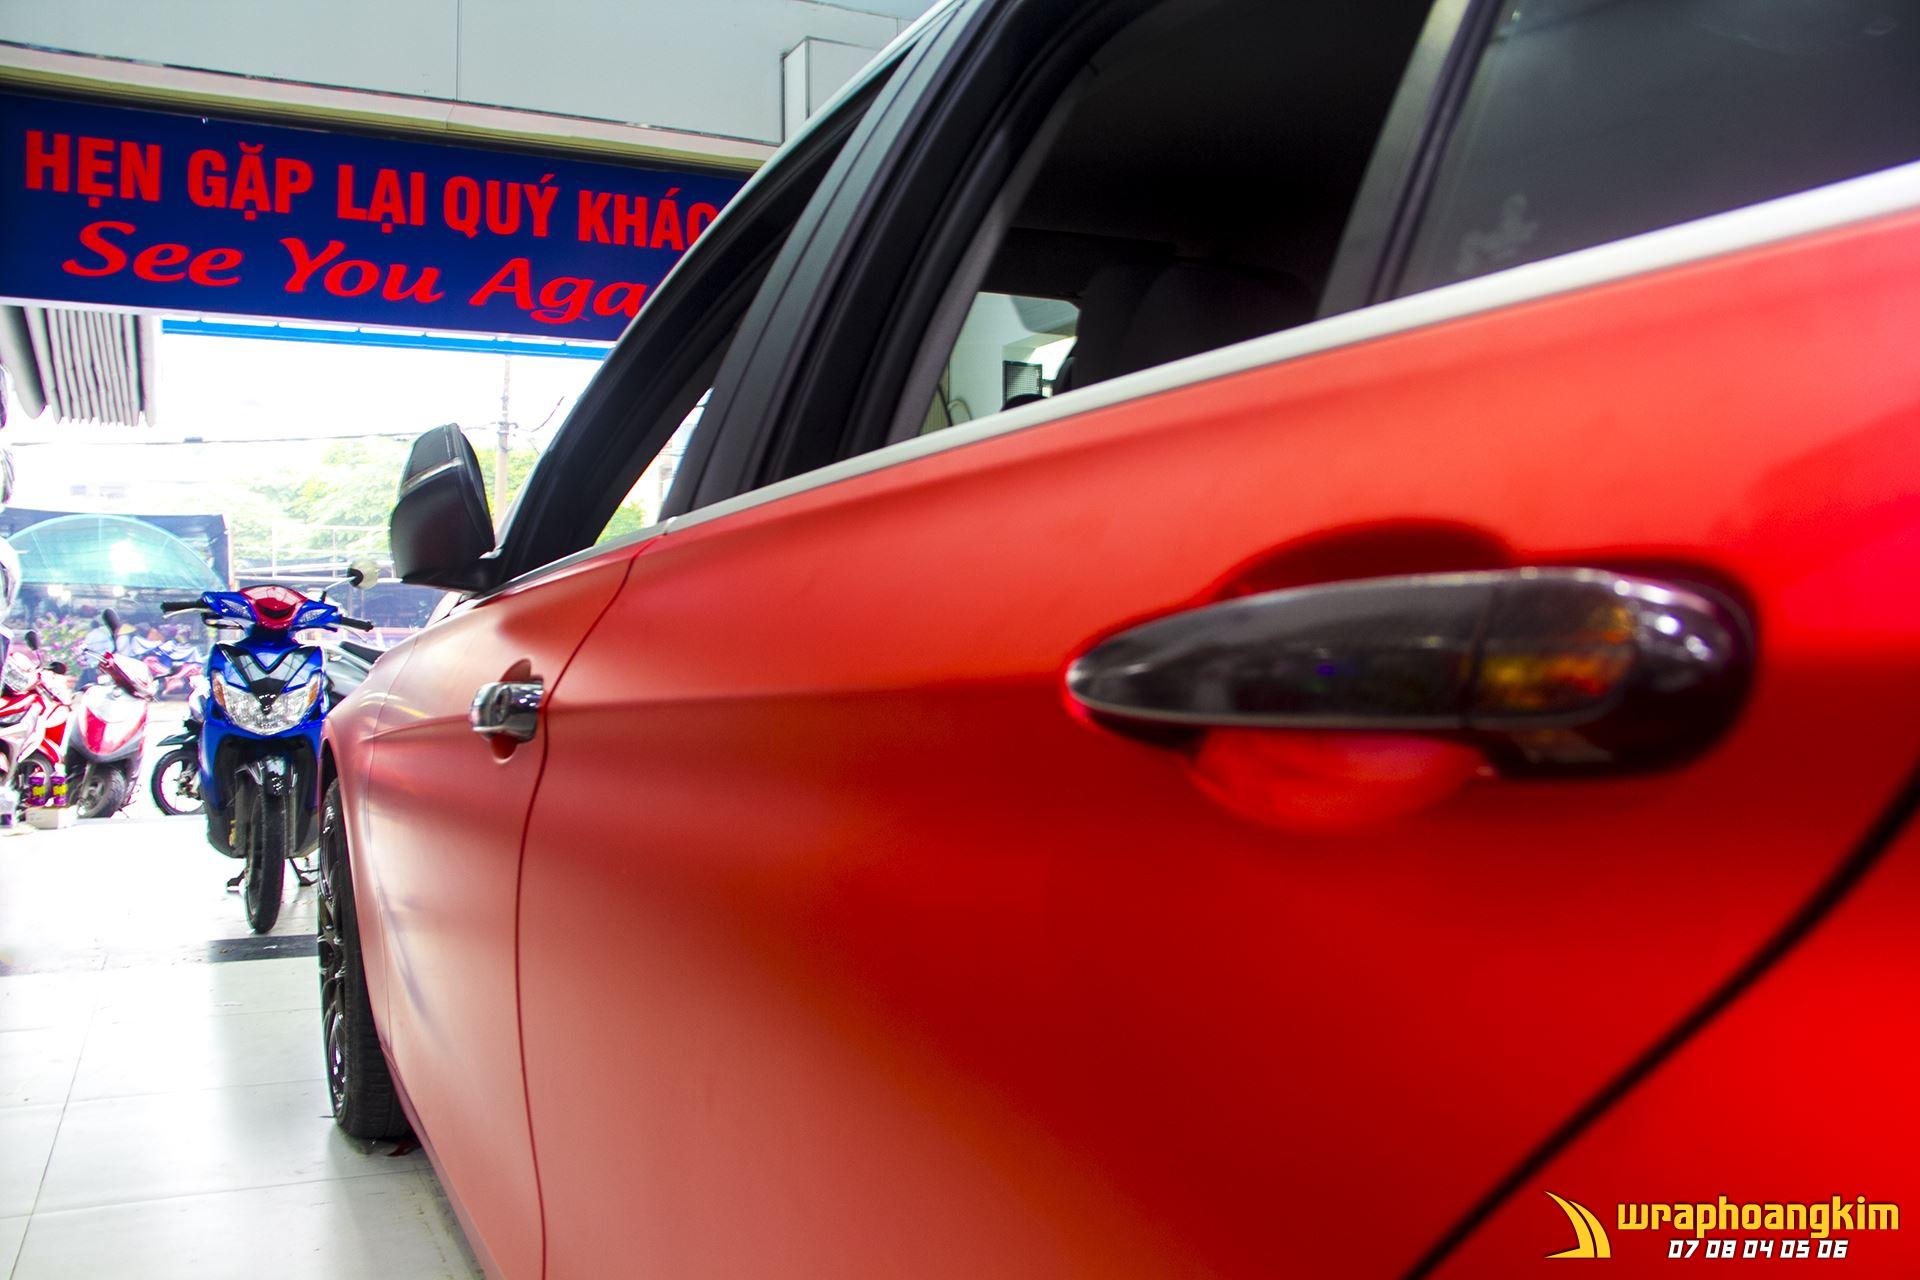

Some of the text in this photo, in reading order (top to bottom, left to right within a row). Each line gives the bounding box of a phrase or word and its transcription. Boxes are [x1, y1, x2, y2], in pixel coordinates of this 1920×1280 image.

[26, 131, 161, 208] HẸN
[187, 142, 313, 221] GẶP
[337, 165, 425, 234] LẠI
[443, 173, 559, 240] QUÝ
[62, 222, 243, 287] See
[280, 238, 443, 303] You
